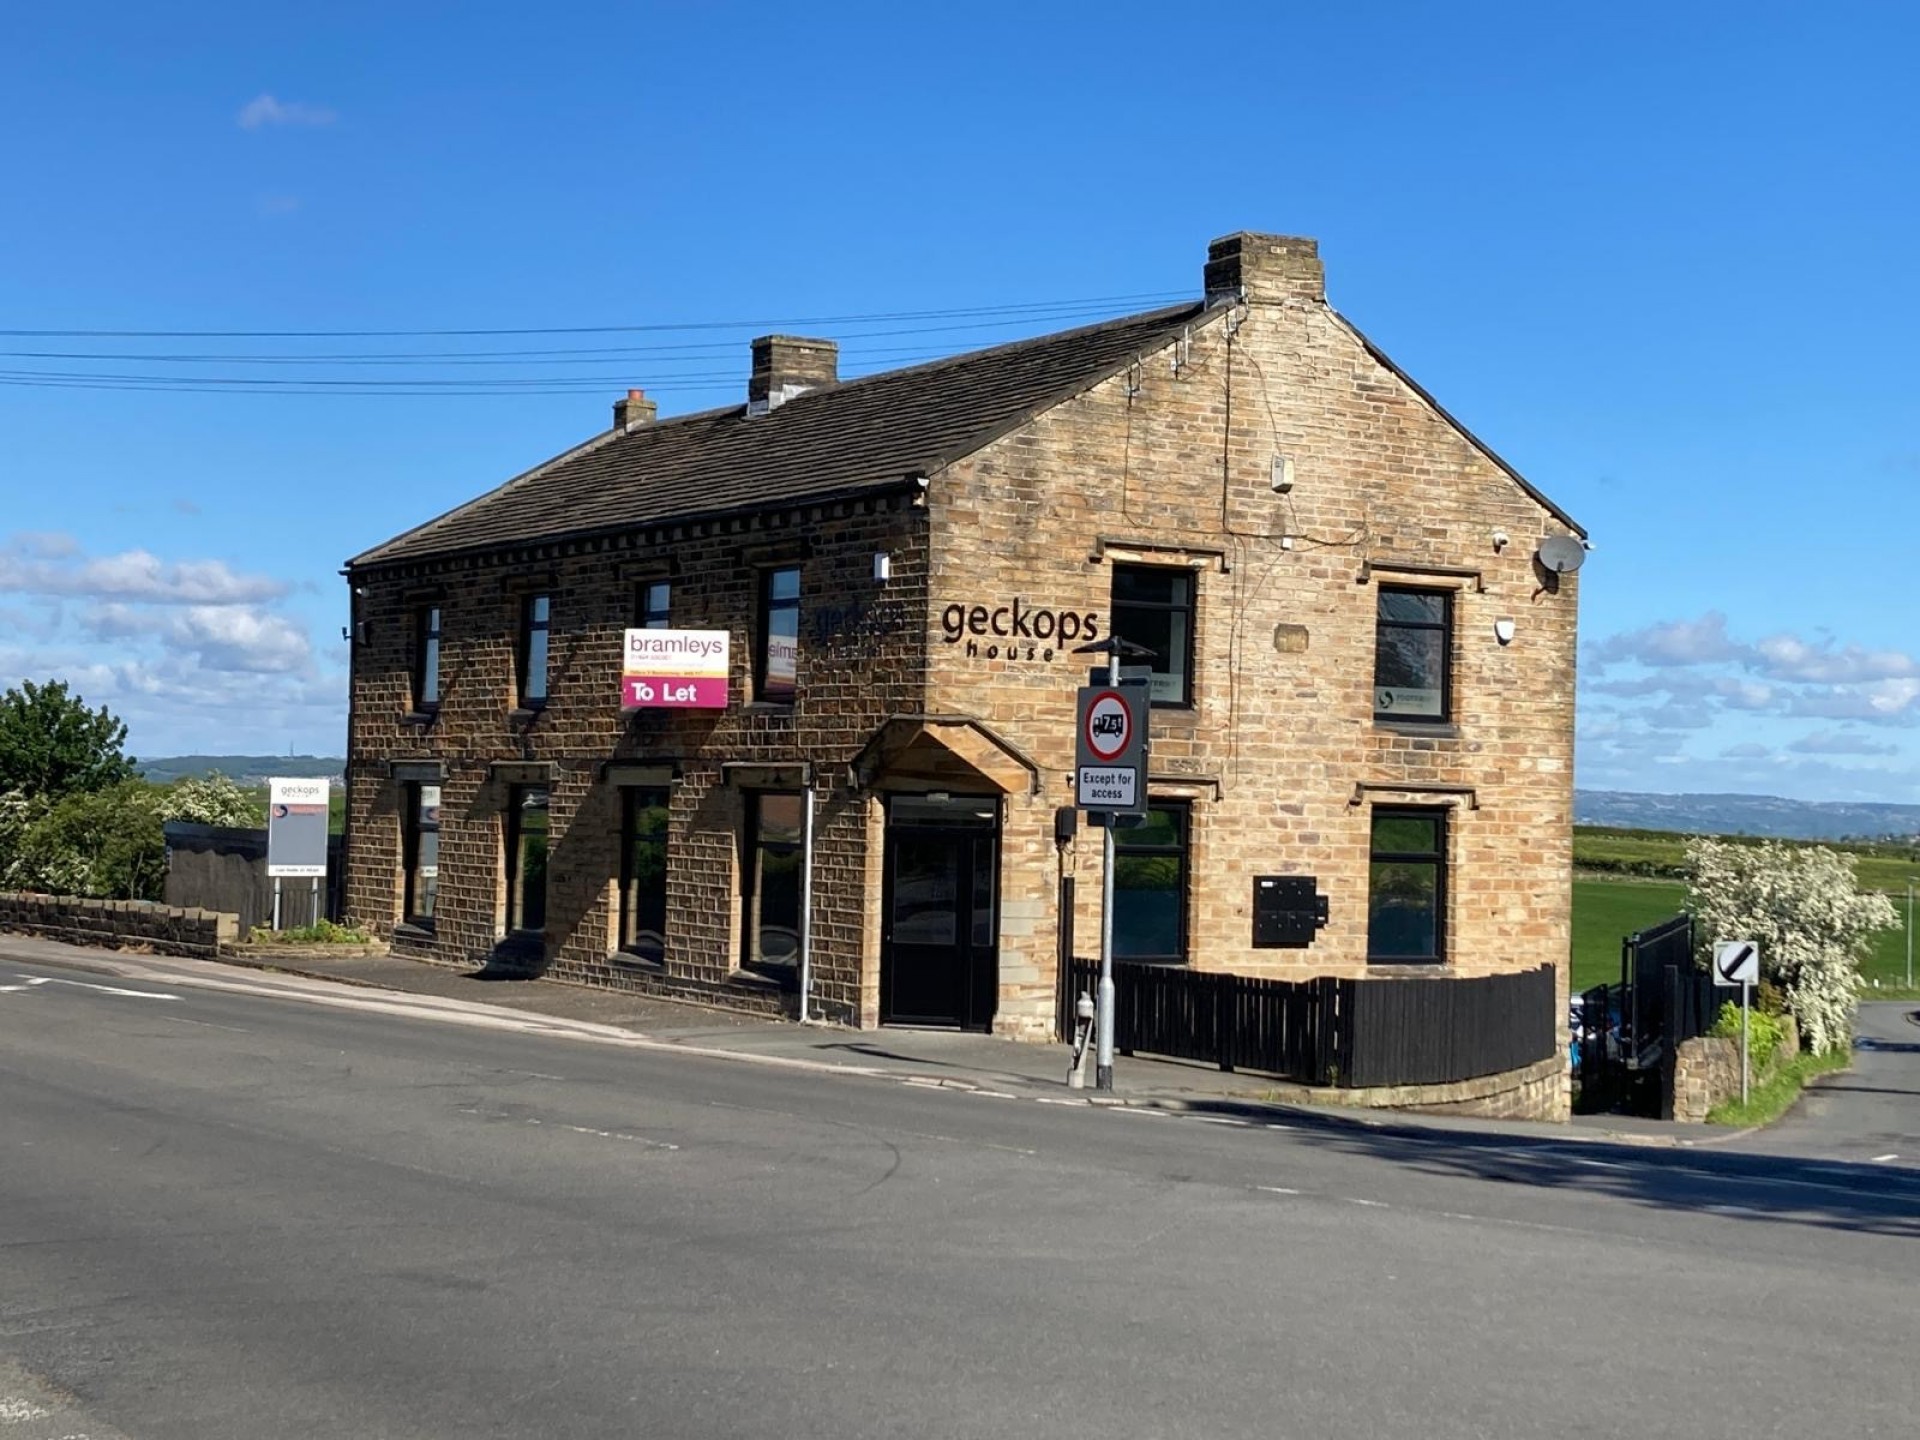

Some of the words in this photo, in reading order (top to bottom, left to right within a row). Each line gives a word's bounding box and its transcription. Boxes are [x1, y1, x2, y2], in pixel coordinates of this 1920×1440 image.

[942, 597, 1098, 650] geckops
[630, 634, 723, 658] bramleys
[966, 638, 1054, 662] house
[631, 682, 655, 701] To
[662, 683, 697, 702] Let
[1083, 772, 1115, 786] Except
[1117, 773, 1132, 785] for
[1091, 789, 1122, 799] access
